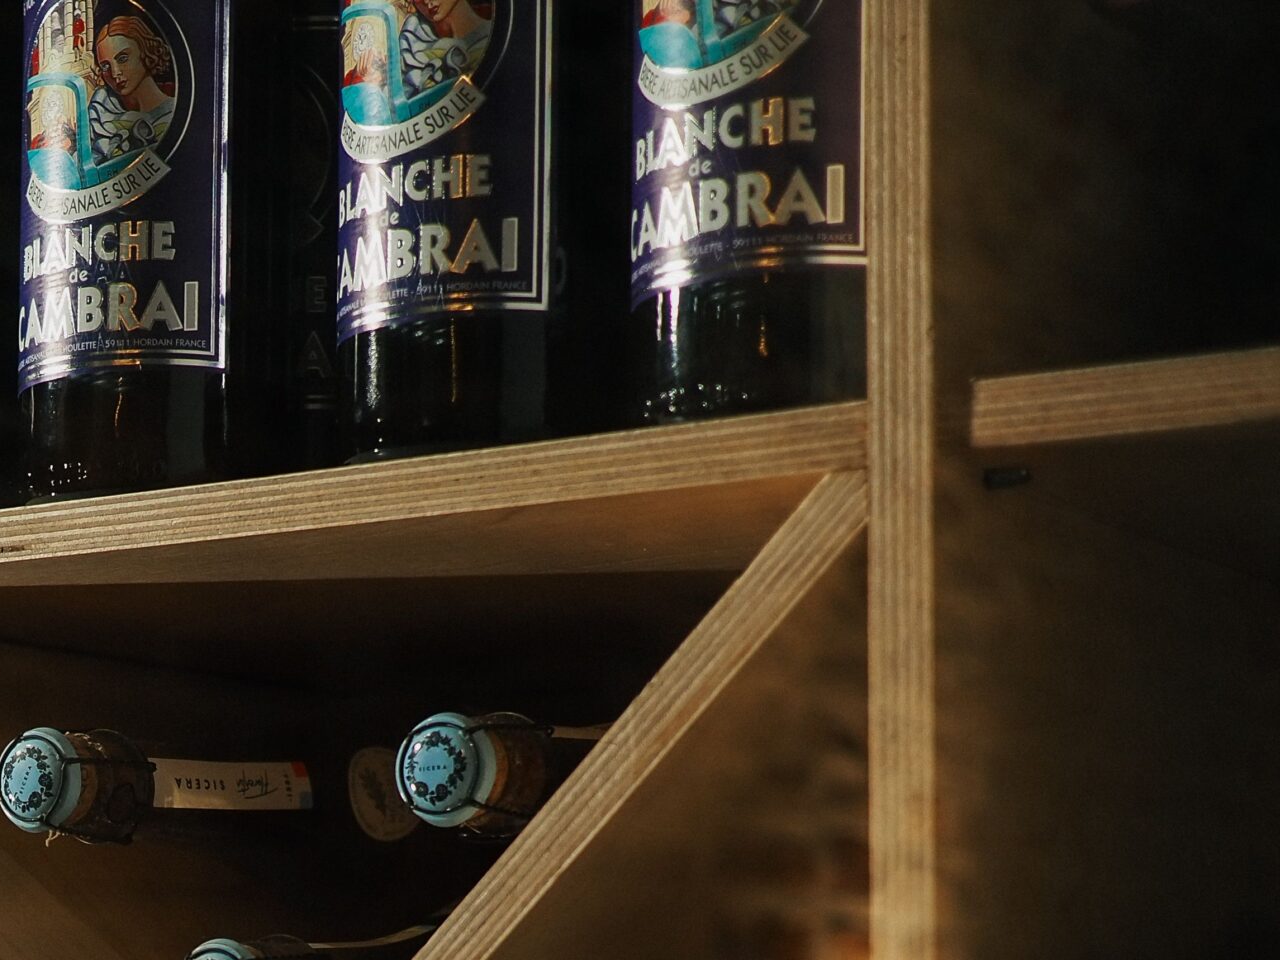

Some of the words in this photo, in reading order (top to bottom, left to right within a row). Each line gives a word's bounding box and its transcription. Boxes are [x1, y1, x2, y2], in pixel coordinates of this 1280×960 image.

[740, 44, 774, 76] SUR
[773, 25, 798, 55] LIE
[428, 107, 455, 134] SUR
[454, 86, 476, 113] LIE
[636, 97, 816, 183] BLANCHE
[113, 173, 141, 199] SUR
[139, 158, 161, 182] LIE
[688, 159, 712, 178] de
[339, 154, 493, 229] BLANCHE
[379, 211, 400, 227] de
[23, 220, 176, 285] BLANCHE
[69, 267, 88, 283] de
[133, 338, 173, 347] HORDAIN
[175, 338, 207, 349] FRANCE
[19, 765, 32, 795] SICERA
[174, 776, 226, 791] SICERA
